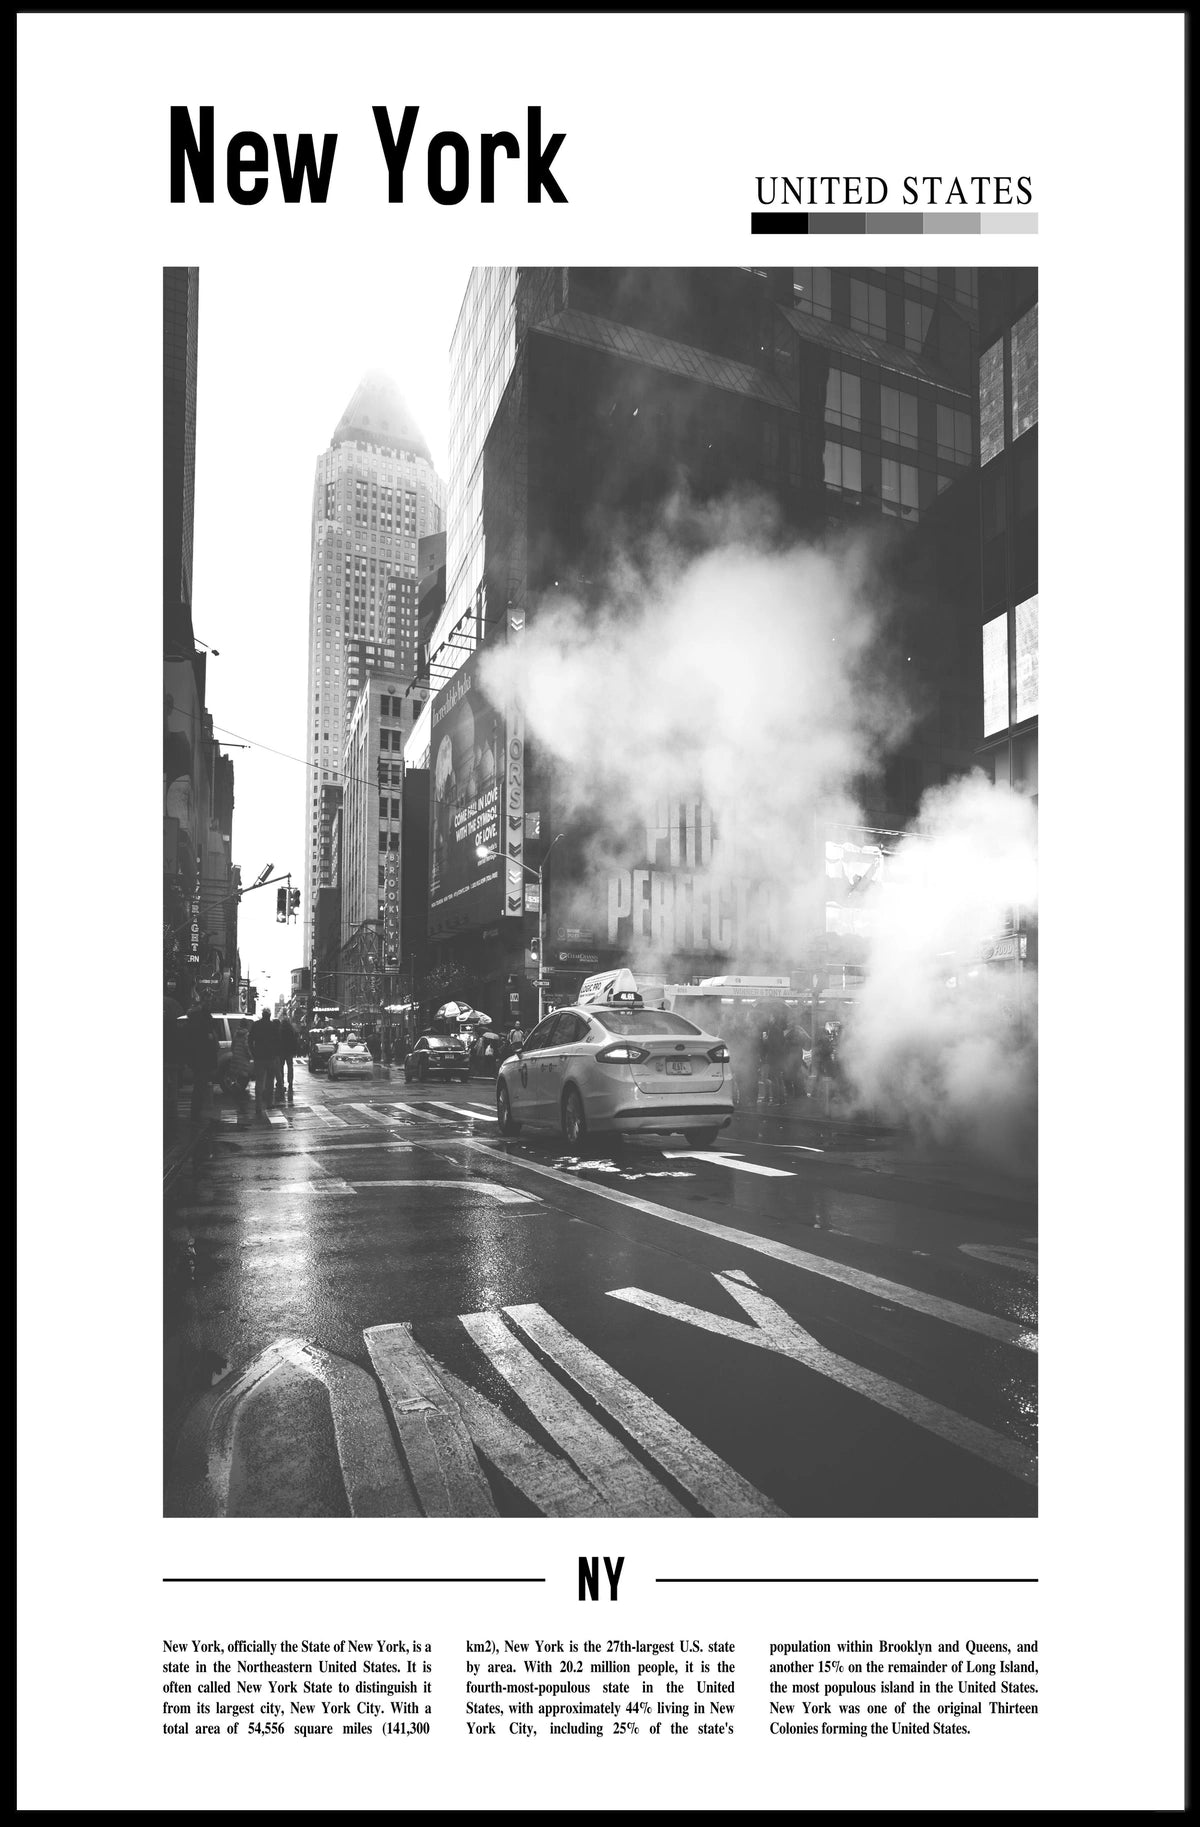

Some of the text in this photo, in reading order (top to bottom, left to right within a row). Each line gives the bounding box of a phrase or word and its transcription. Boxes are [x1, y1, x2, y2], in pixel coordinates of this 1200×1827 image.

[454, 787, 498, 827] COME FALL IN LOVE
[455, 805, 498, 843] WITH THE SYMBOL
[475, 823, 498, 847] OF LOVE.
[388, 853, 396, 955] BROOKLYN
[607, 867, 751, 951] PERFECT
